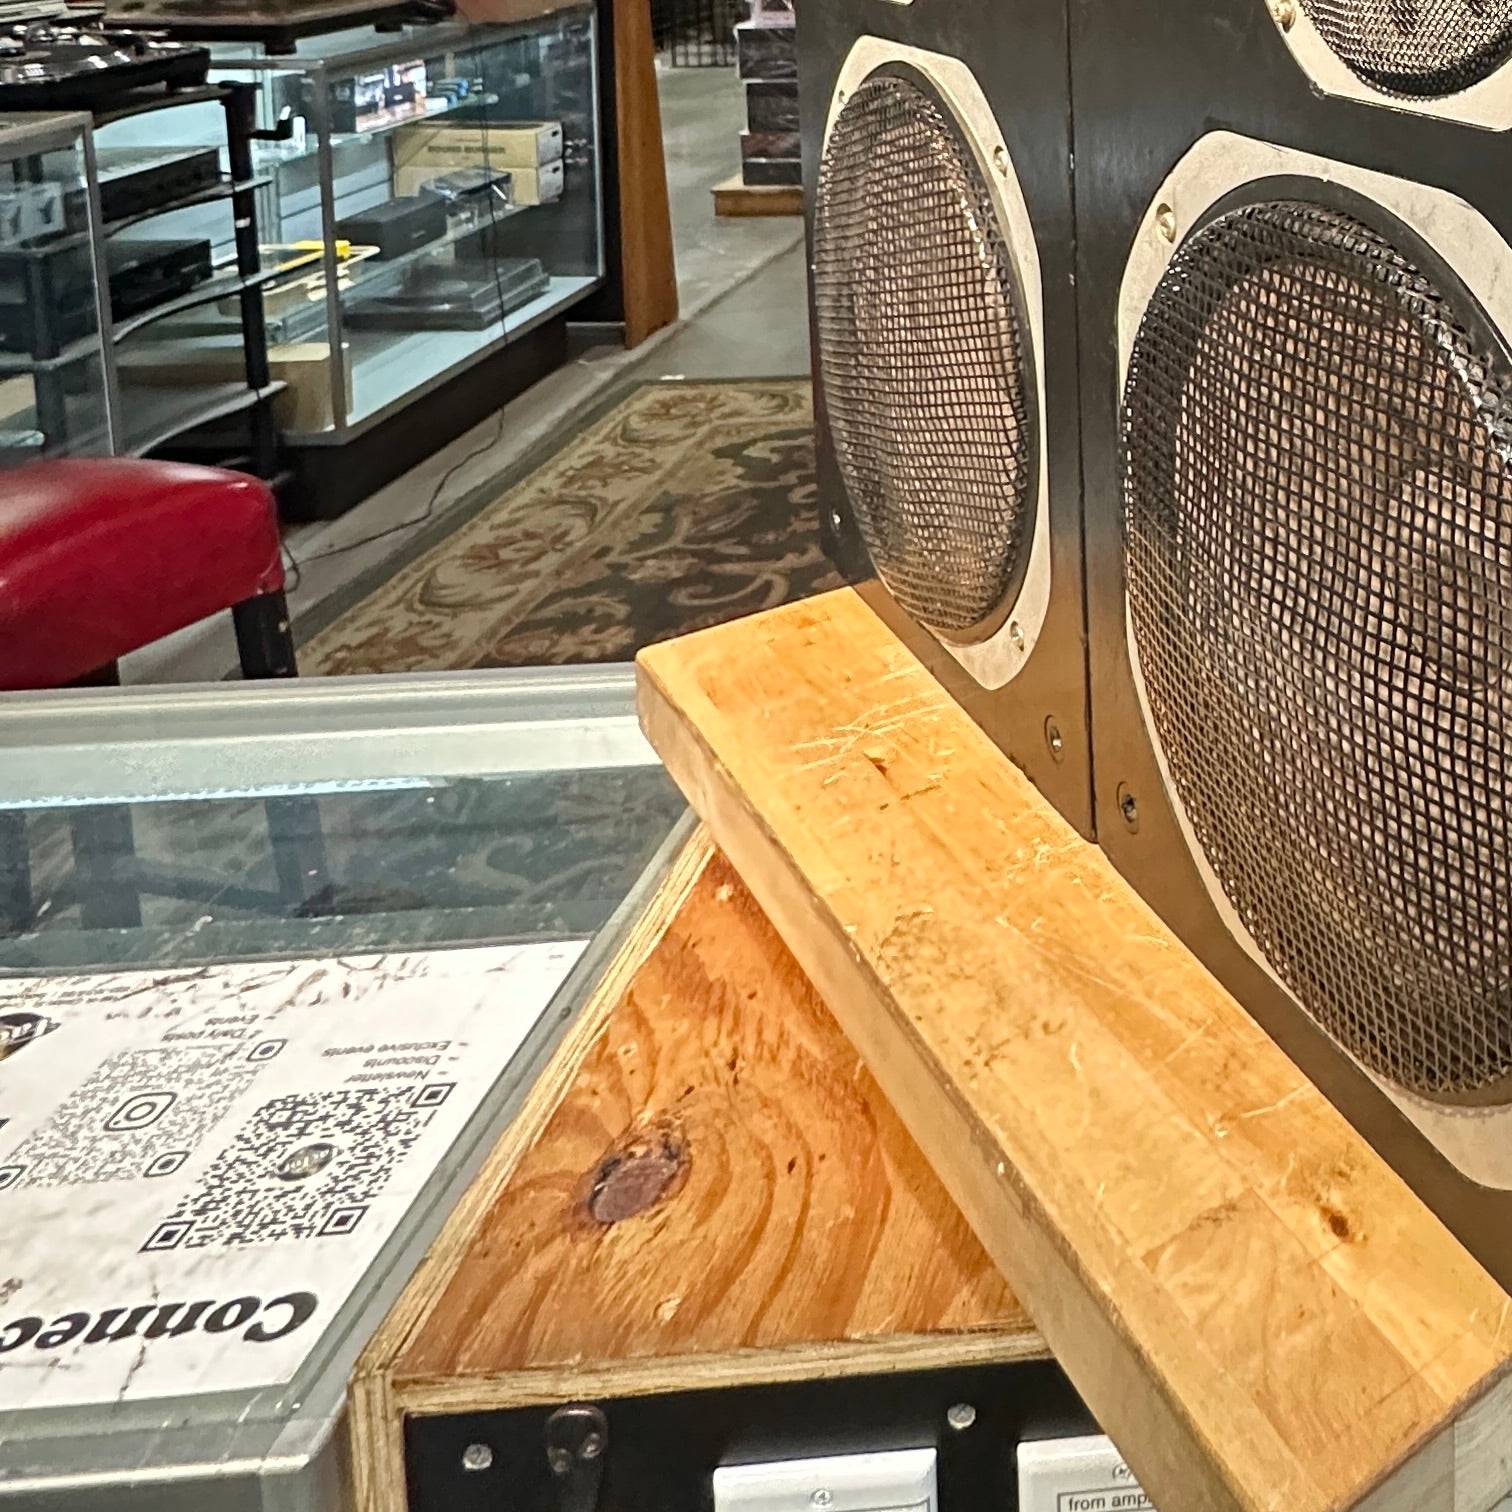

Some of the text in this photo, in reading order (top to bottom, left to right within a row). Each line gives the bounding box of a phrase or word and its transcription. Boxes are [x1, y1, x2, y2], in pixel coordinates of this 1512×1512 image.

[321, 1040, 452, 1057] Exclusive events
[362, 1054, 441, 1068] Discounts
[343, 1069, 431, 1084] Newsletter
[1069, 1497, 1106, 1512] from
